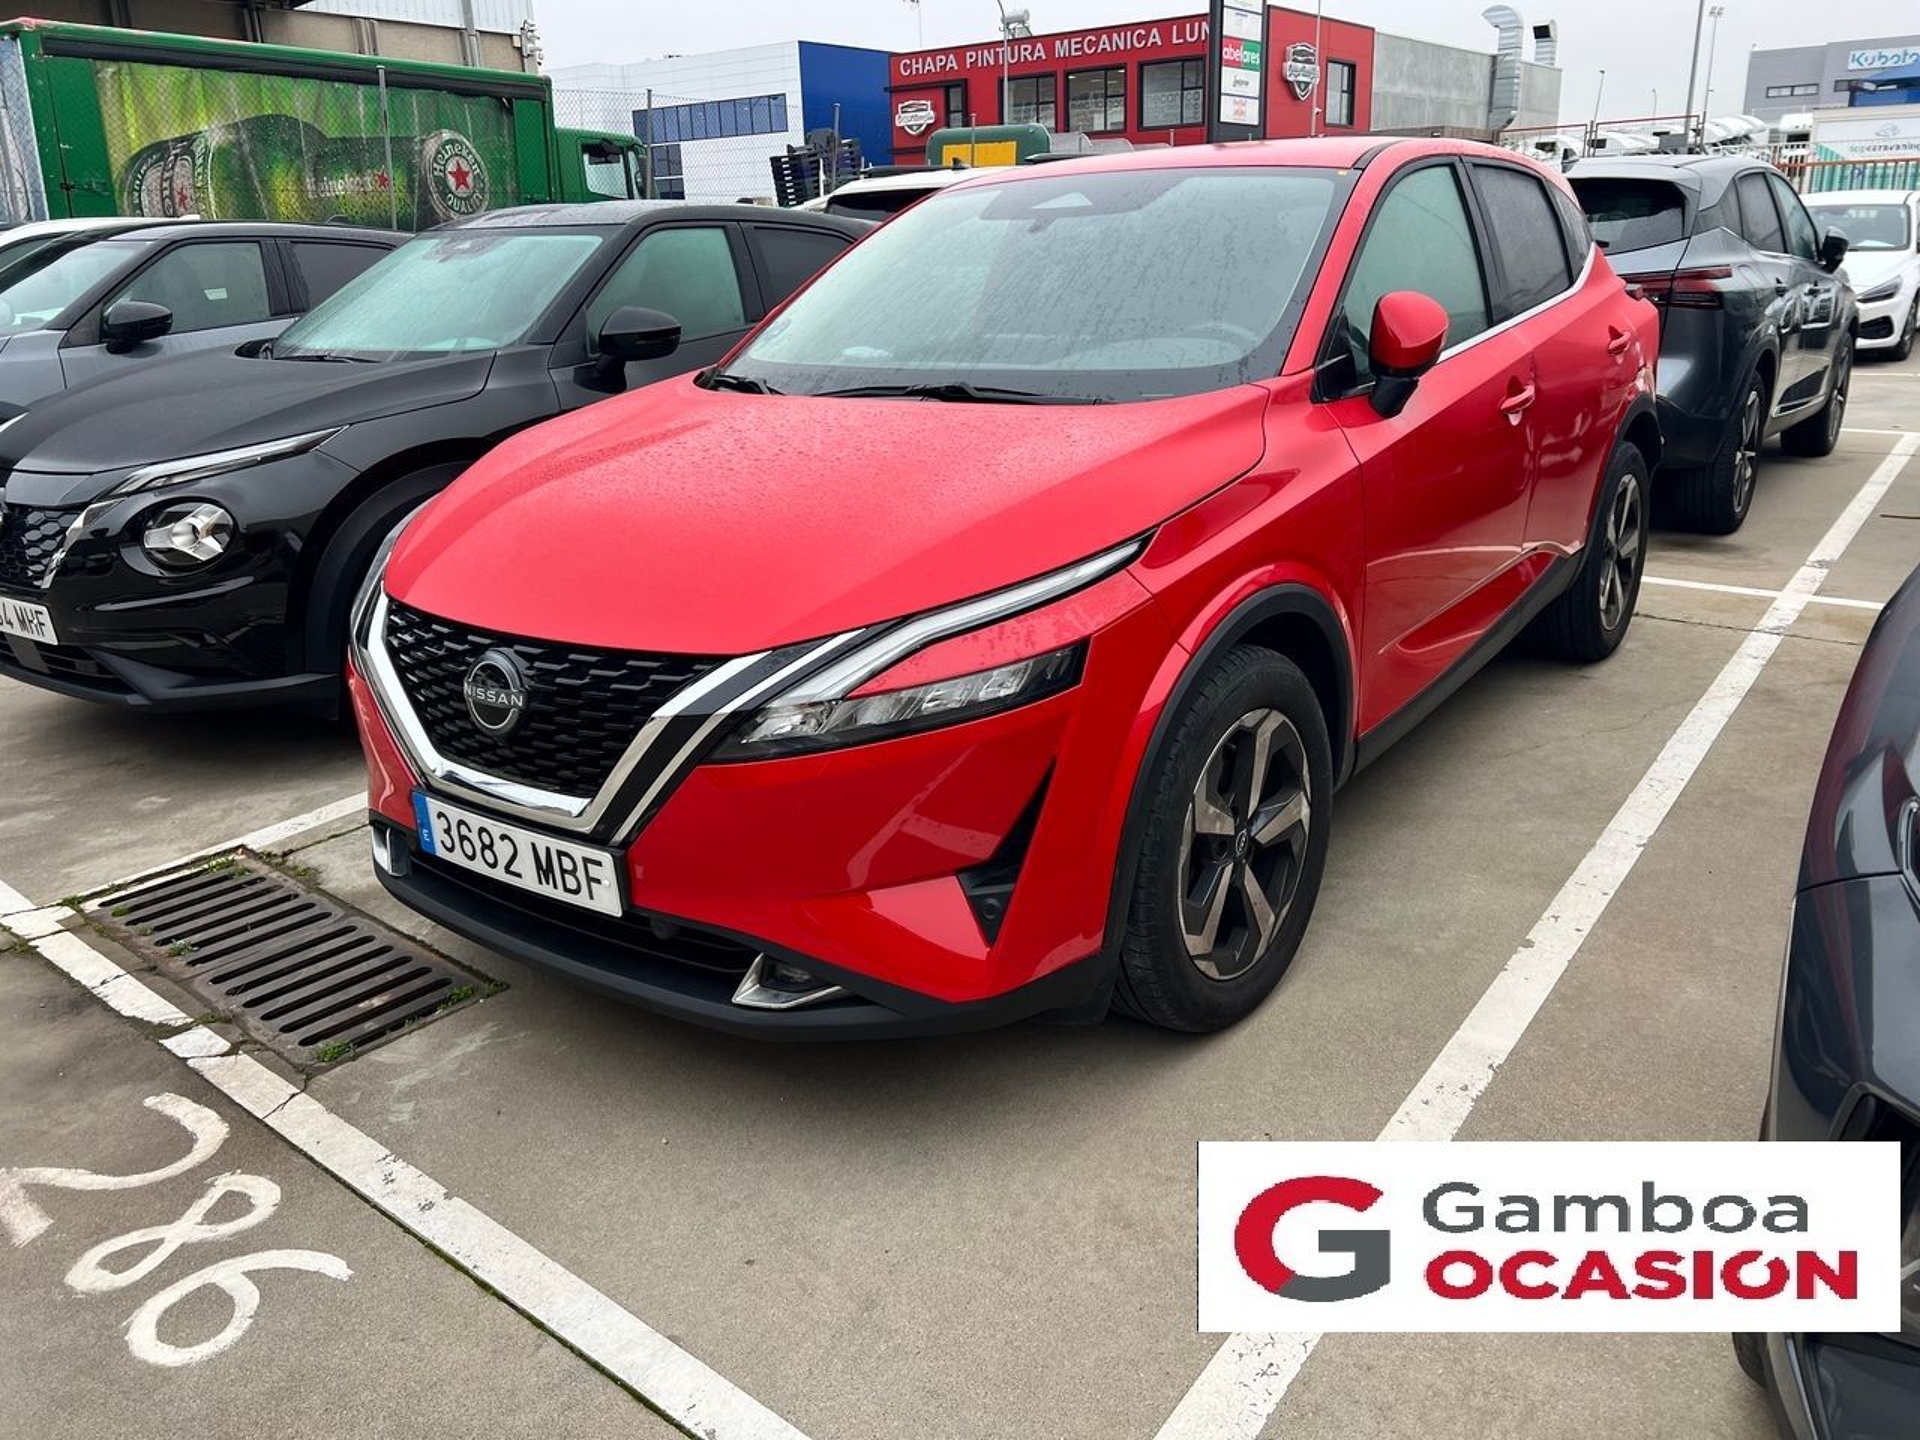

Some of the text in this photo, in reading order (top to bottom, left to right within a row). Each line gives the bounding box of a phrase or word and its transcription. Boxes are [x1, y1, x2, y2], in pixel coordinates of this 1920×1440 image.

[900, 53, 958, 76] CHAPA
[966, 42, 1046, 69] PINTURA
[1055, 29, 1162, 59] MECANICA
[433, 143, 481, 177] Heineken
[13, 604, 46, 637] MHF
[464, 682, 523, 708] NISSAN
[422, 828, 431, 842] E
[436, 811, 603, 900] 3682 MBF
[0, 1091, 354, 1367] 286
